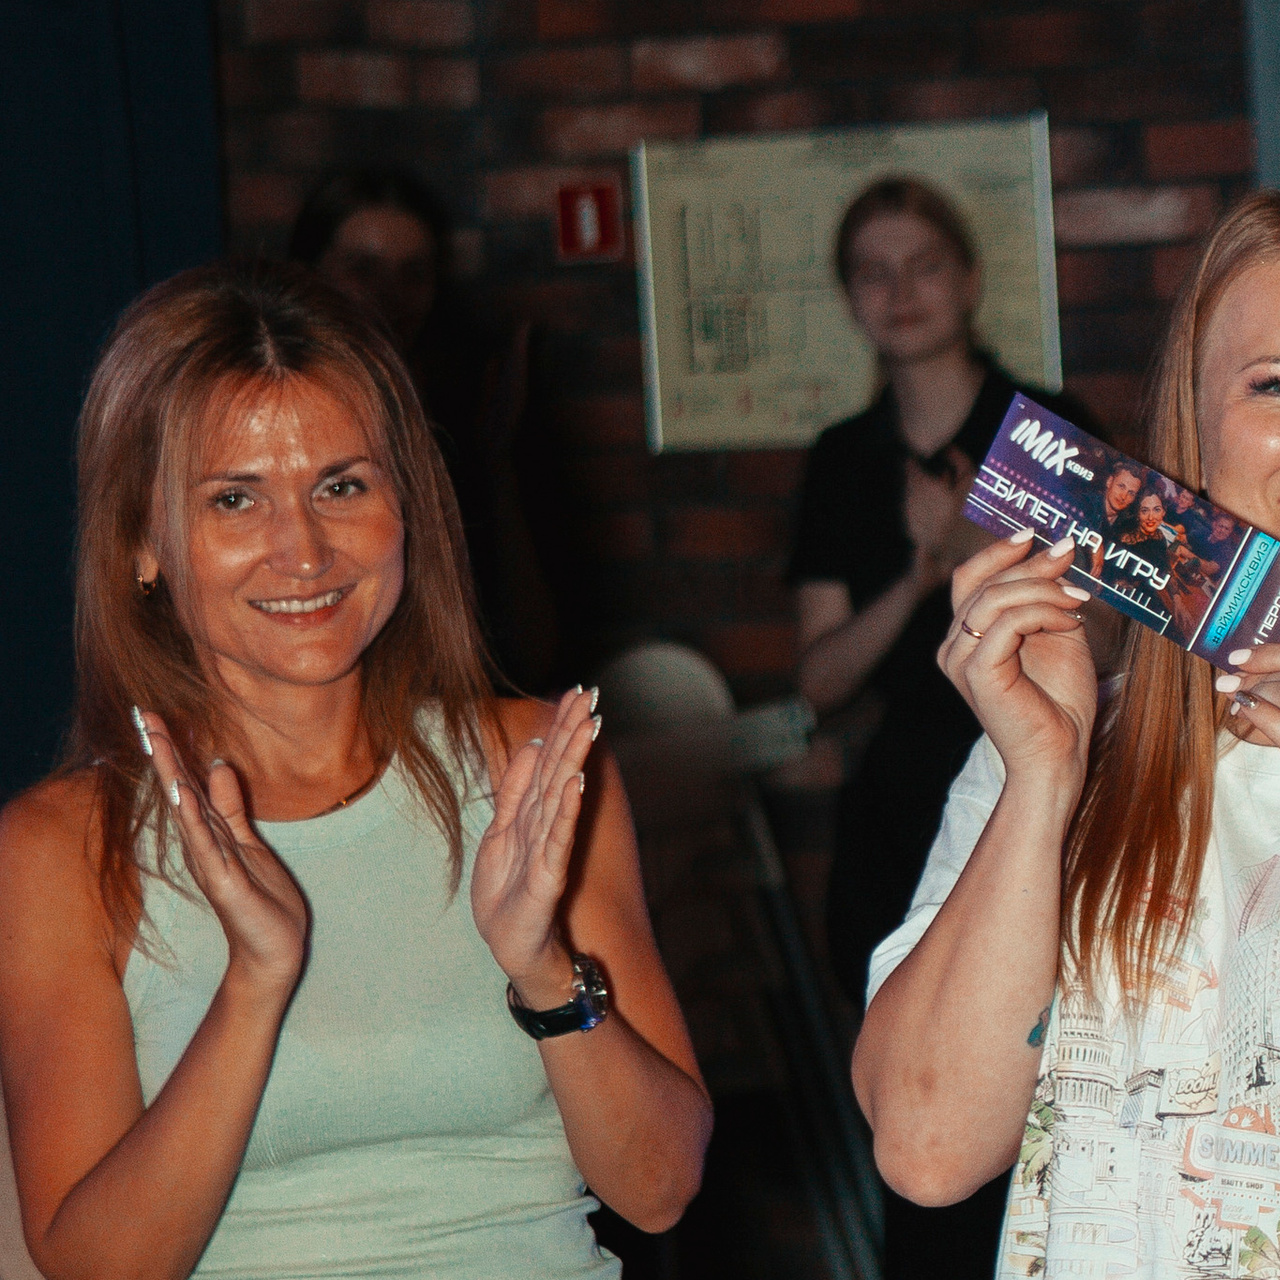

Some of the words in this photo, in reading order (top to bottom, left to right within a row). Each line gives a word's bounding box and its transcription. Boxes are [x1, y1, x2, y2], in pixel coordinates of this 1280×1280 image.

[1010, 419, 1079, 476] IMIX
[993, 476, 1068, 530] БИЛЕТ
[1065, 519, 1103, 554] НА
[1104, 542, 1172, 591] ИГРУ
[1212, 541, 1270, 644] #АЙМИКСКВИЗ
[1176, 1072, 1217, 1095] BOOM!
